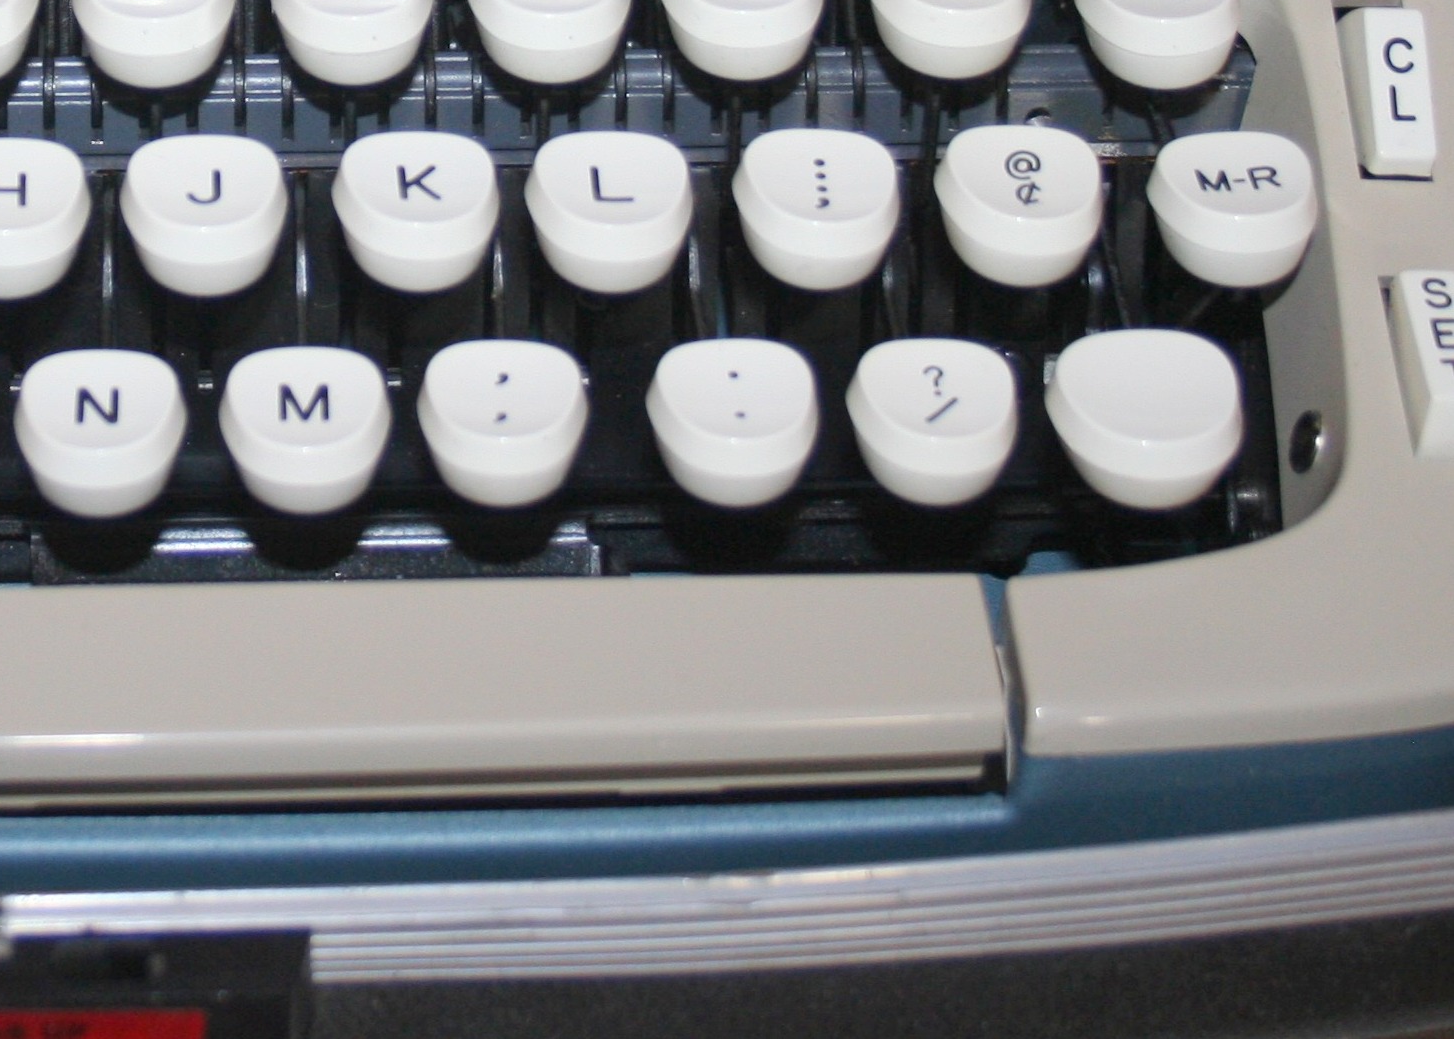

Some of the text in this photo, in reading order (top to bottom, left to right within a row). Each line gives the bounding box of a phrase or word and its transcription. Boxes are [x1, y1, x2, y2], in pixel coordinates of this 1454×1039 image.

[397, 165, 441, 200] K
[1004, 150, 1042, 180] @
[1195, 166, 1281, 192] M-R
[188, 169, 222, 205] J
[590, 166, 634, 202] L
[923, 365, 944, 396] ?
[76, 388, 120, 425] N
[279, 384, 330, 421] M
